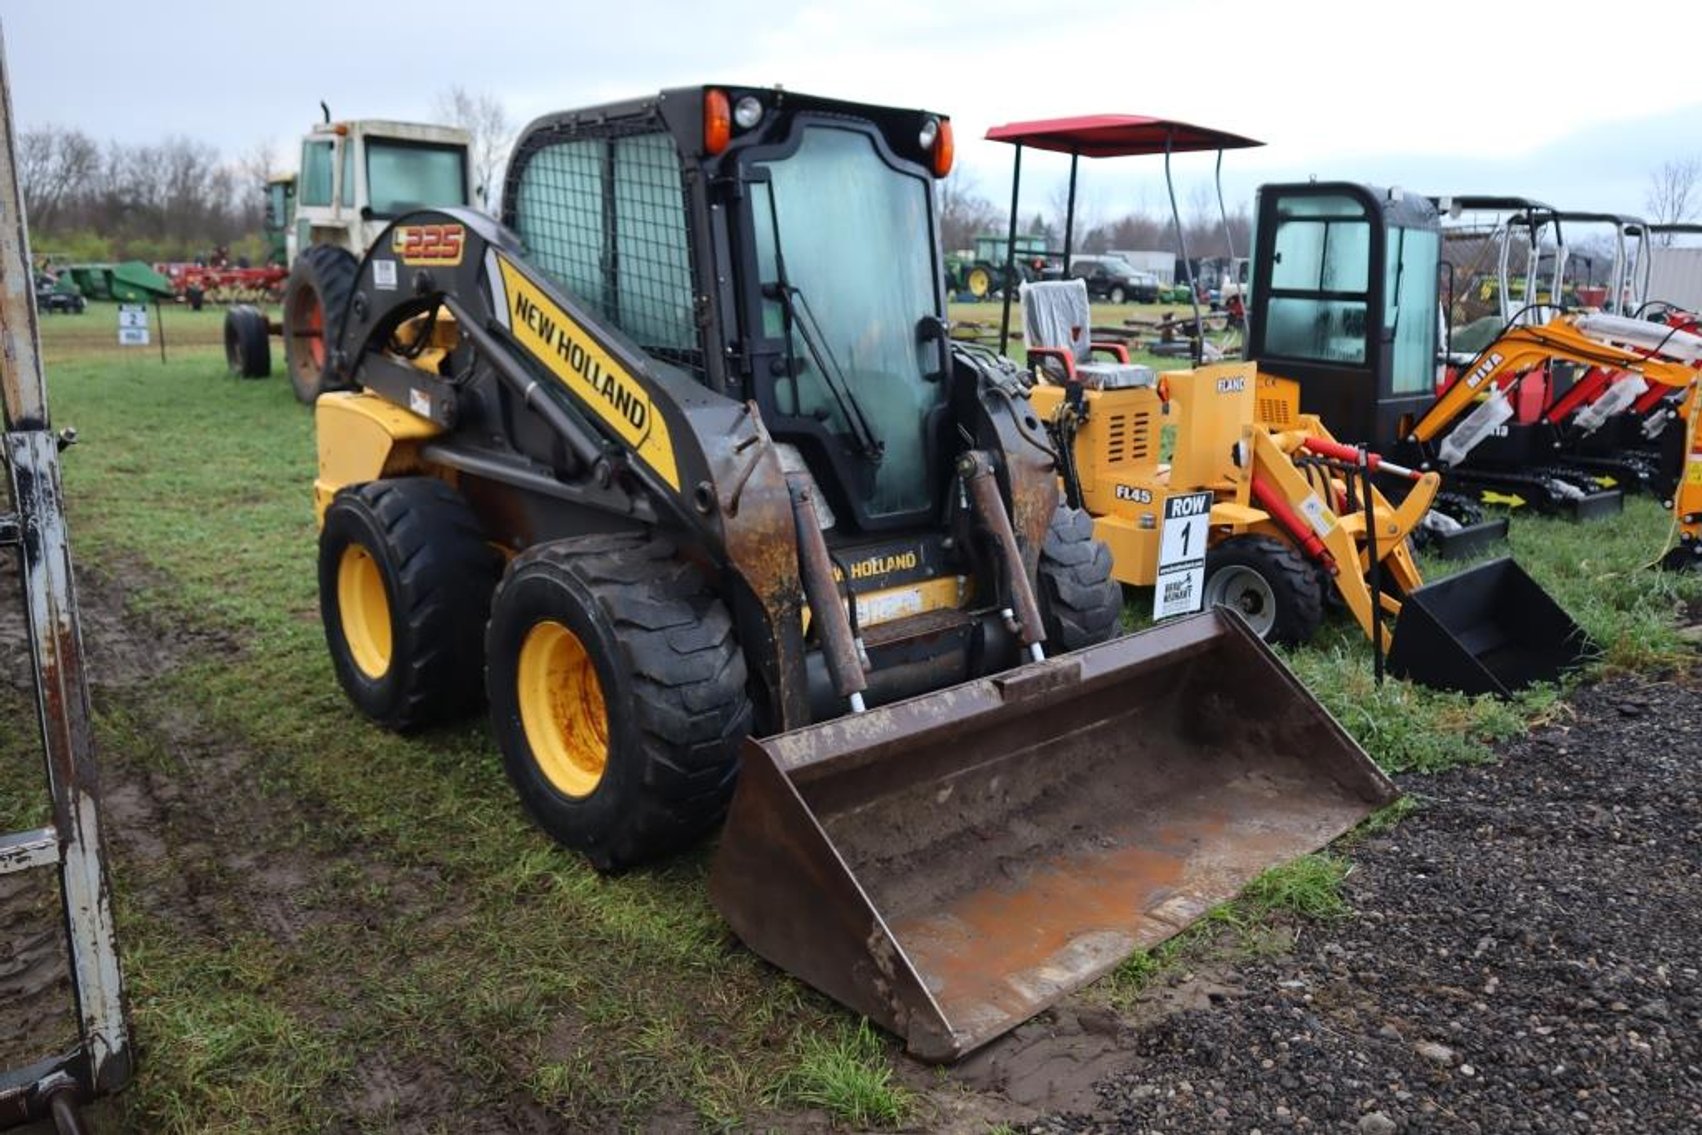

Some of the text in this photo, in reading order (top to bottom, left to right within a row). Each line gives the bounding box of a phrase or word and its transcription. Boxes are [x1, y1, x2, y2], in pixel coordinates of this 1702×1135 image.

[515, 291, 647, 430] NEW HOLLAND
[1467, 353, 1504, 389] MIVA
[1116, 486, 1152, 503] FL45
[1172, 495, 1206, 517] ROW
[1181, 521, 1191, 556] 1
[851, 552, 917, 579] HOLLAND
